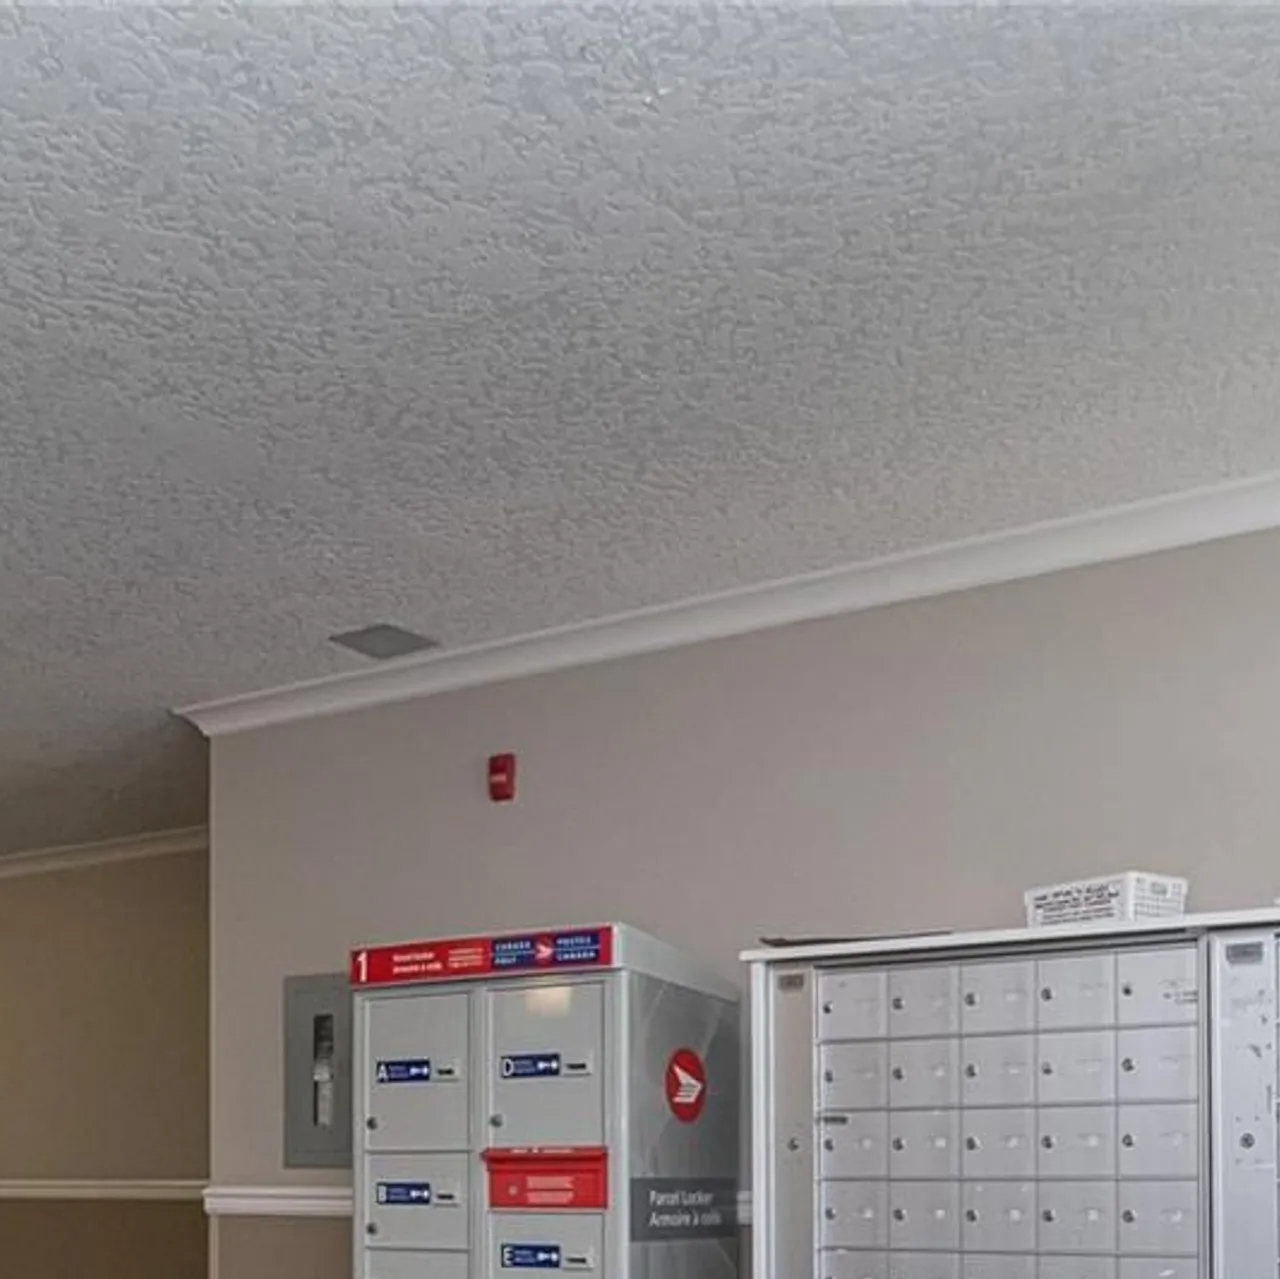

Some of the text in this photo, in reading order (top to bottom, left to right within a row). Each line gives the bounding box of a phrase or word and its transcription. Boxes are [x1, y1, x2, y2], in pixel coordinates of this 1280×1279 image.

[357, 951, 368, 982] 1
[377, 1063, 389, 1082] A
[503, 1058, 514, 1076] D
[503, 1246, 514, 1265] E
